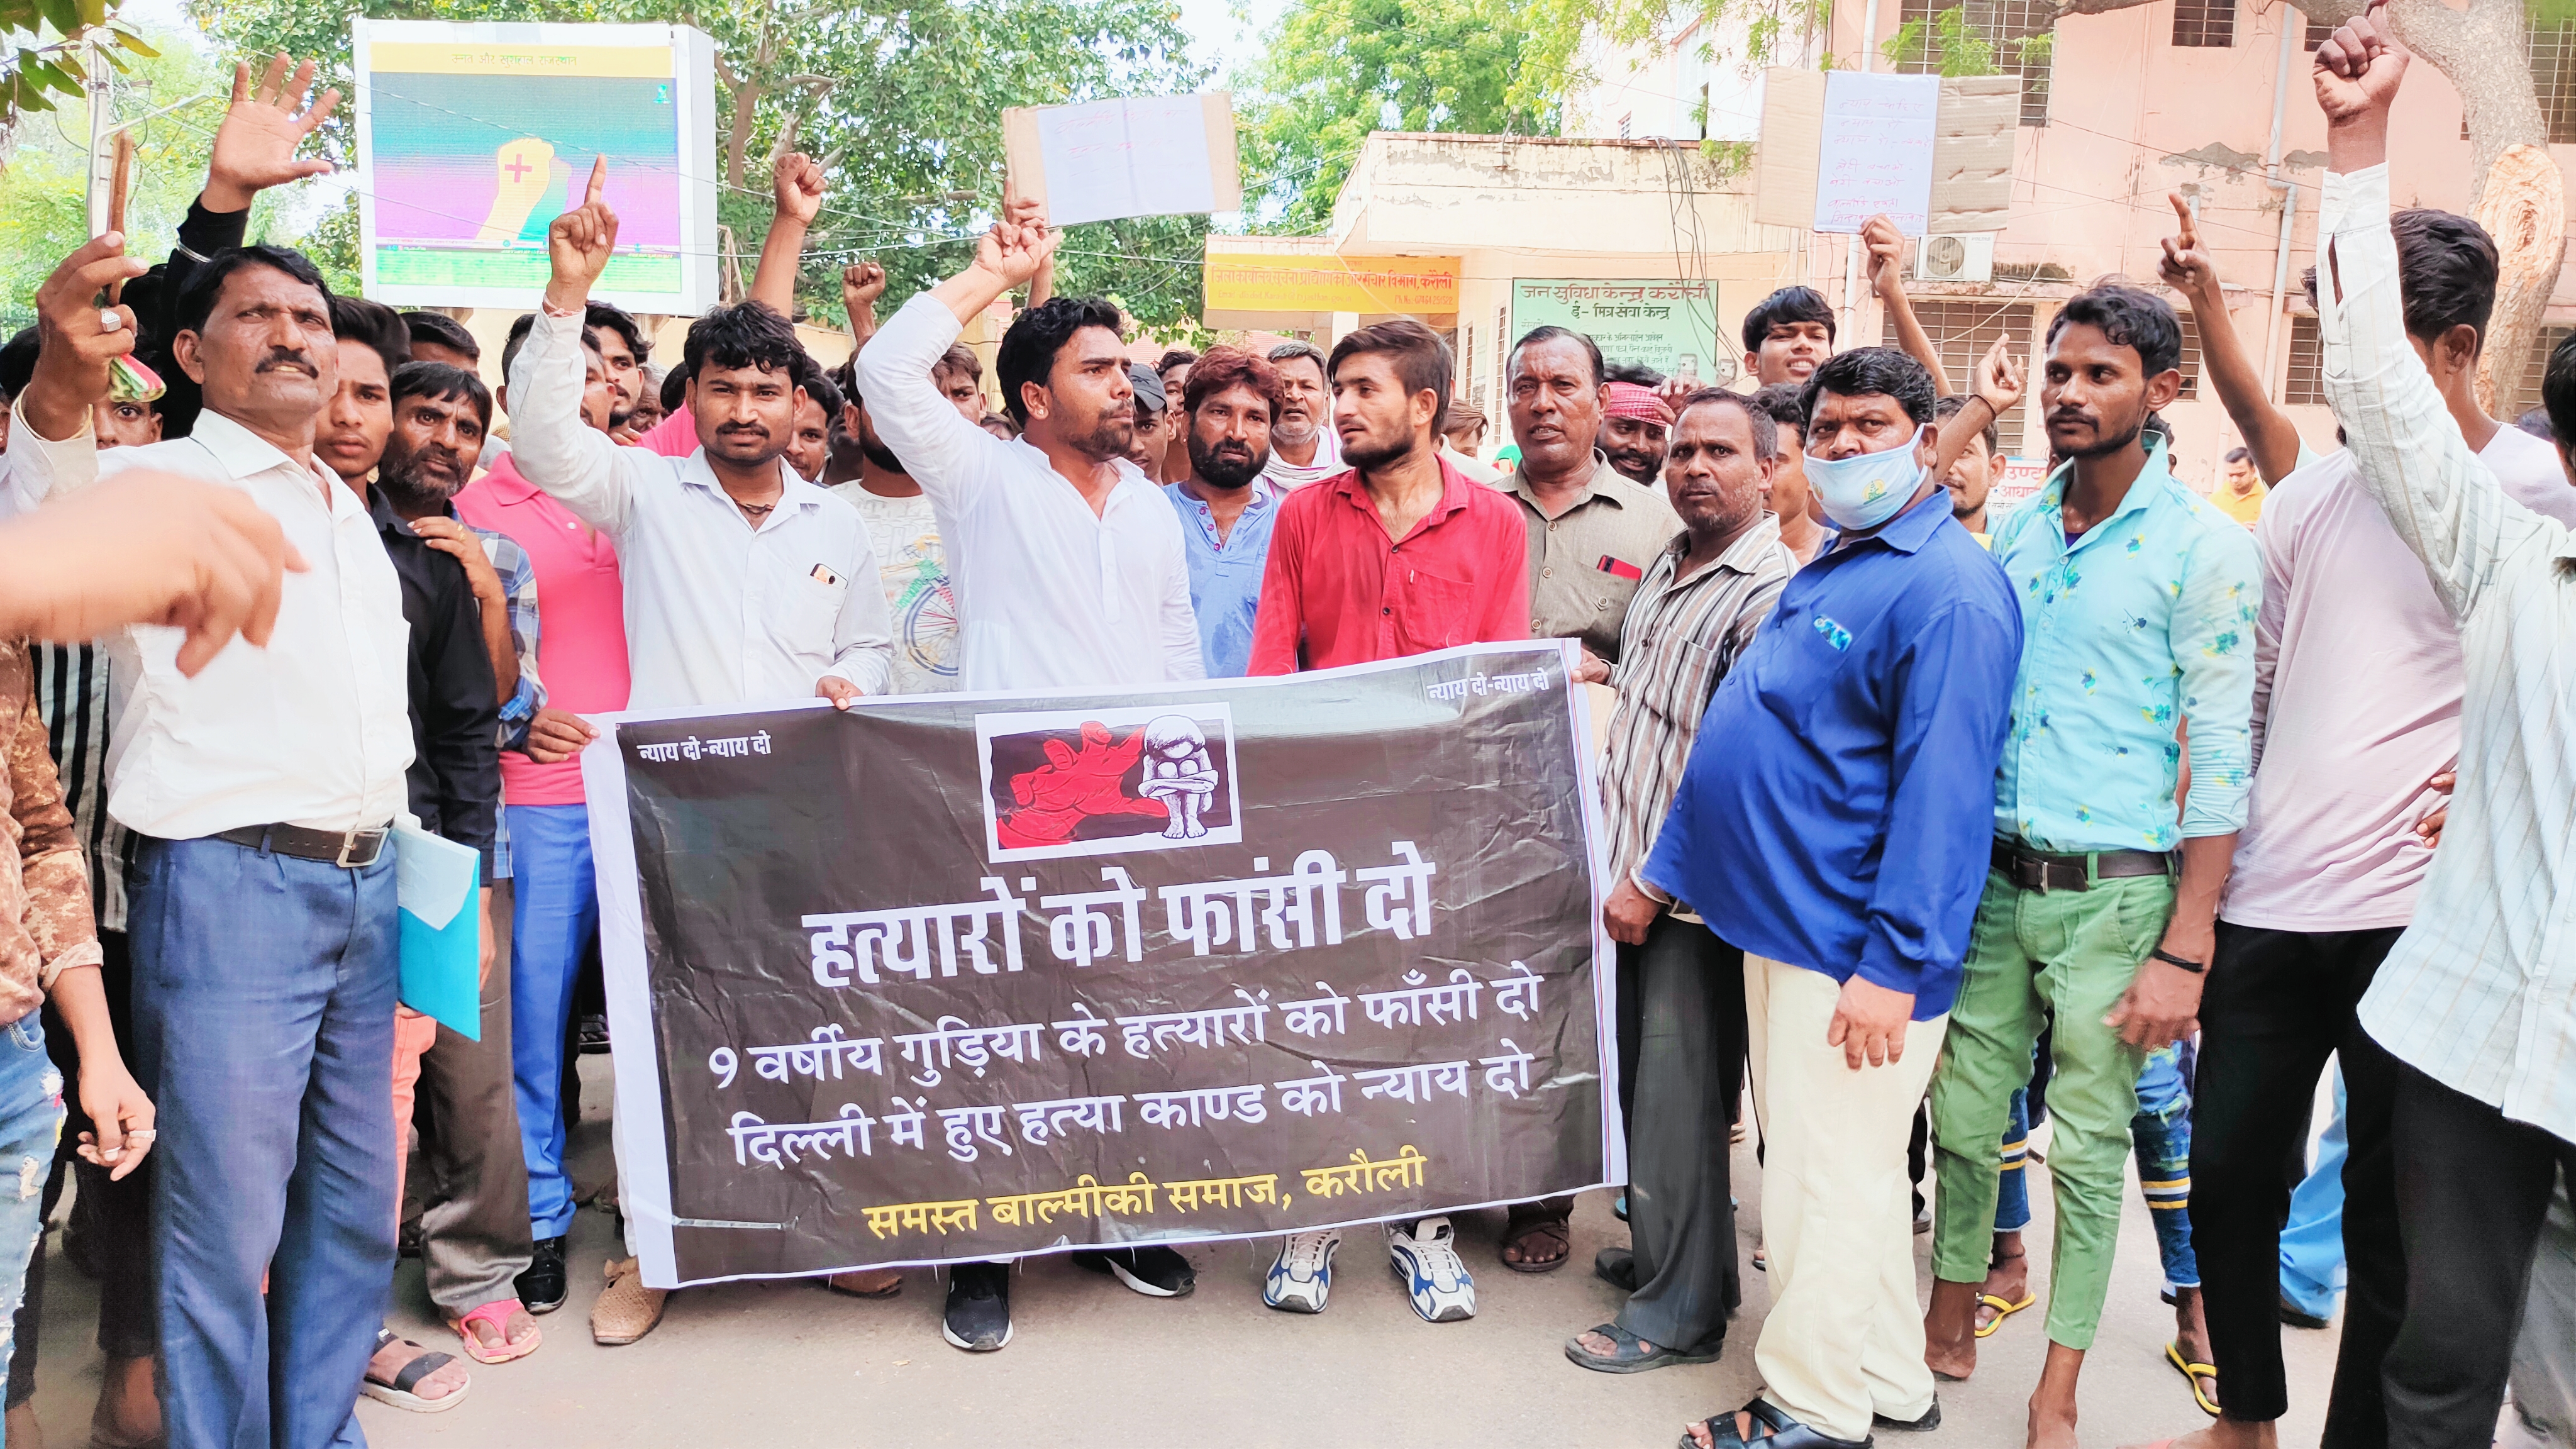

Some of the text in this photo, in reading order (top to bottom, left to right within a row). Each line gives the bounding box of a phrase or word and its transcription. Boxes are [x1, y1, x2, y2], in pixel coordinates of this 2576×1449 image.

[479, 52, 495, 64] और
[499, 55, 533, 68] खुशहाल
[538, 55, 577, 65] राजस्थान
[1211, 265, 1235, 284] जिला
[1519, 285, 1552, 298] जन
[1552, 283, 1601, 304] सुविधा
[1601, 282, 1646, 303] केन्द्र
[1592, 303, 1615, 318] मित्र
[1615, 303, 1641, 318] सेवा
[1643, 303, 1670, 319] केन्द्र
[1426, 678, 1468, 702] न्याय
[636, 742, 679, 763] न्याय
[801, 841, 1438, 989] हत्यारों को फांसी दो
[746, 1022, 884, 1084] वर्षीय
[892, 1014, 1045, 1087] गुड़िया
[1052, 1002, 1109, 1058] के
[1114, 982, 1271, 1060] हत्यारों
[1277, 980, 1352, 1039] को
[1356, 968, 1484, 1030] फाँसी
[1489, 960, 1545, 1022] दो
[726, 1036, 1536, 1170] दिल्ली में हुए हत्या काण्ड को न्याय दो
[860, 1145, 1428, 1240] समस्त बाल्मीकी समाज, करौली
